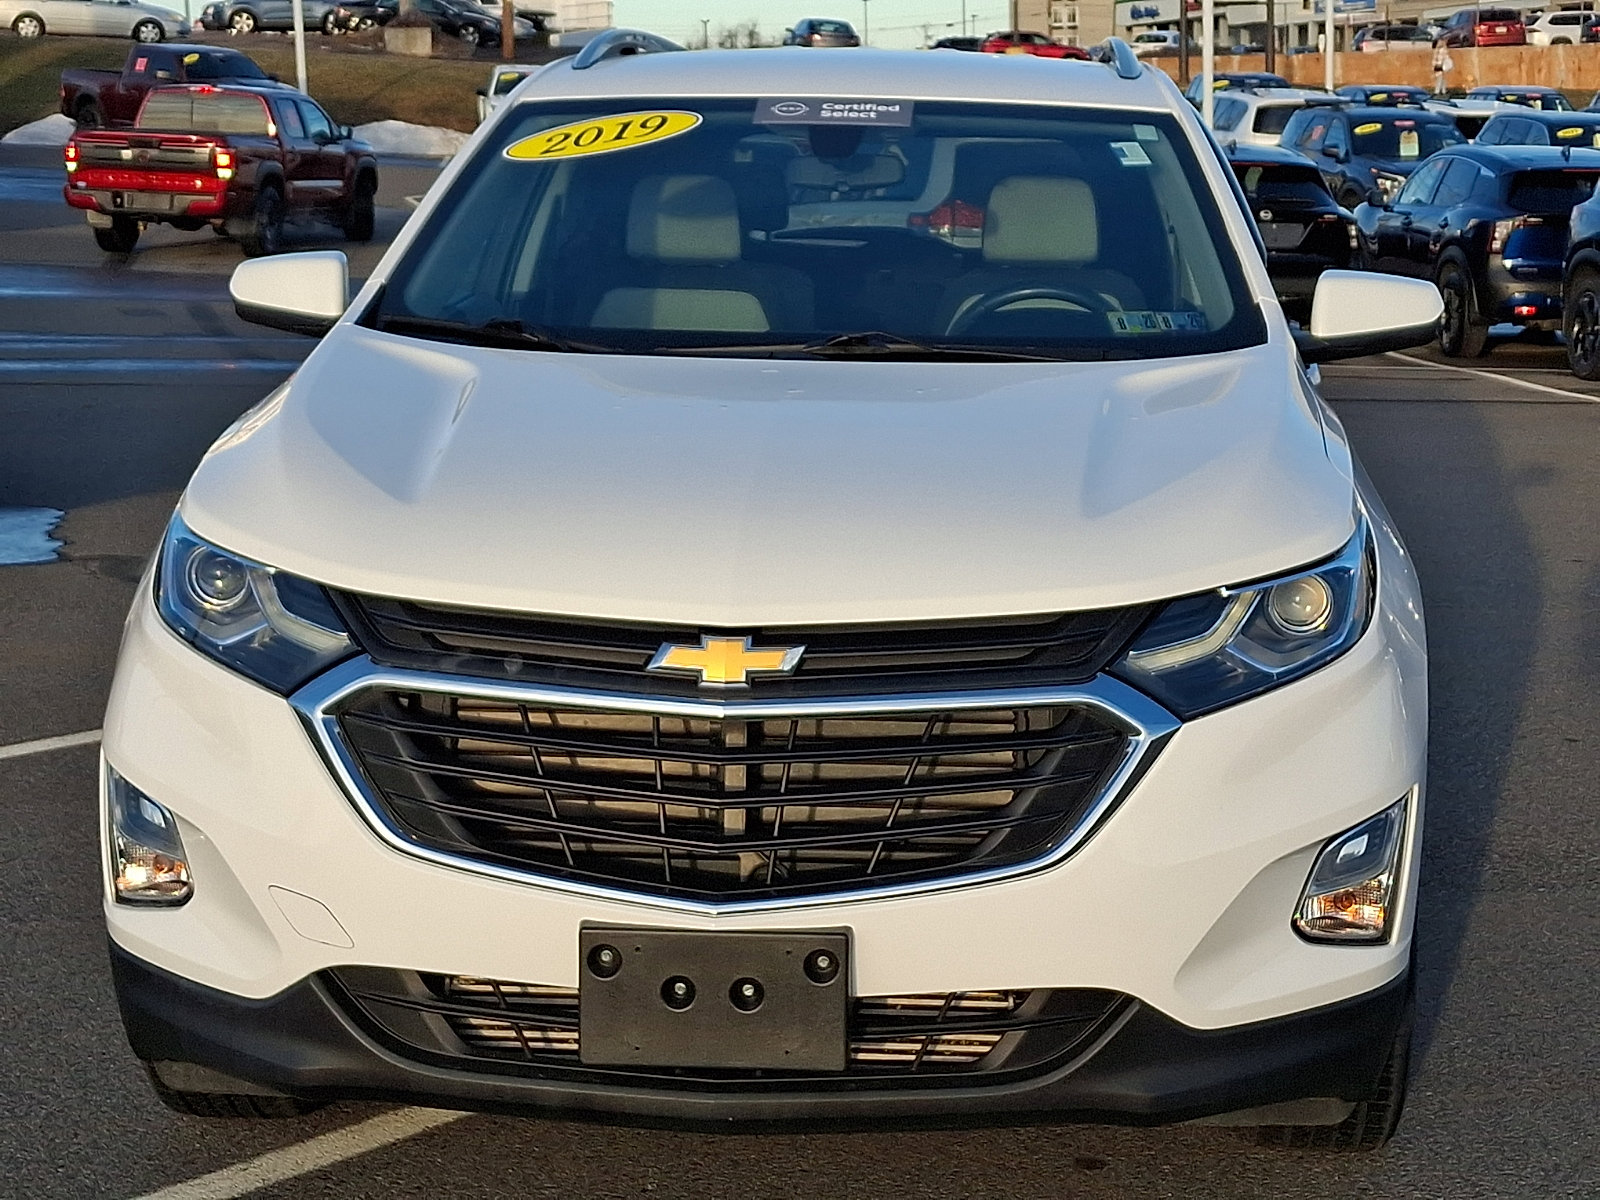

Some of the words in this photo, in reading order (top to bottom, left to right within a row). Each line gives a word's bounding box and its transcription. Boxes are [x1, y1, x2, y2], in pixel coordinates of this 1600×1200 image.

[822, 102, 900, 112] Certified
[820, 110, 877, 119] Select
[539, 115, 670, 155] 2019
